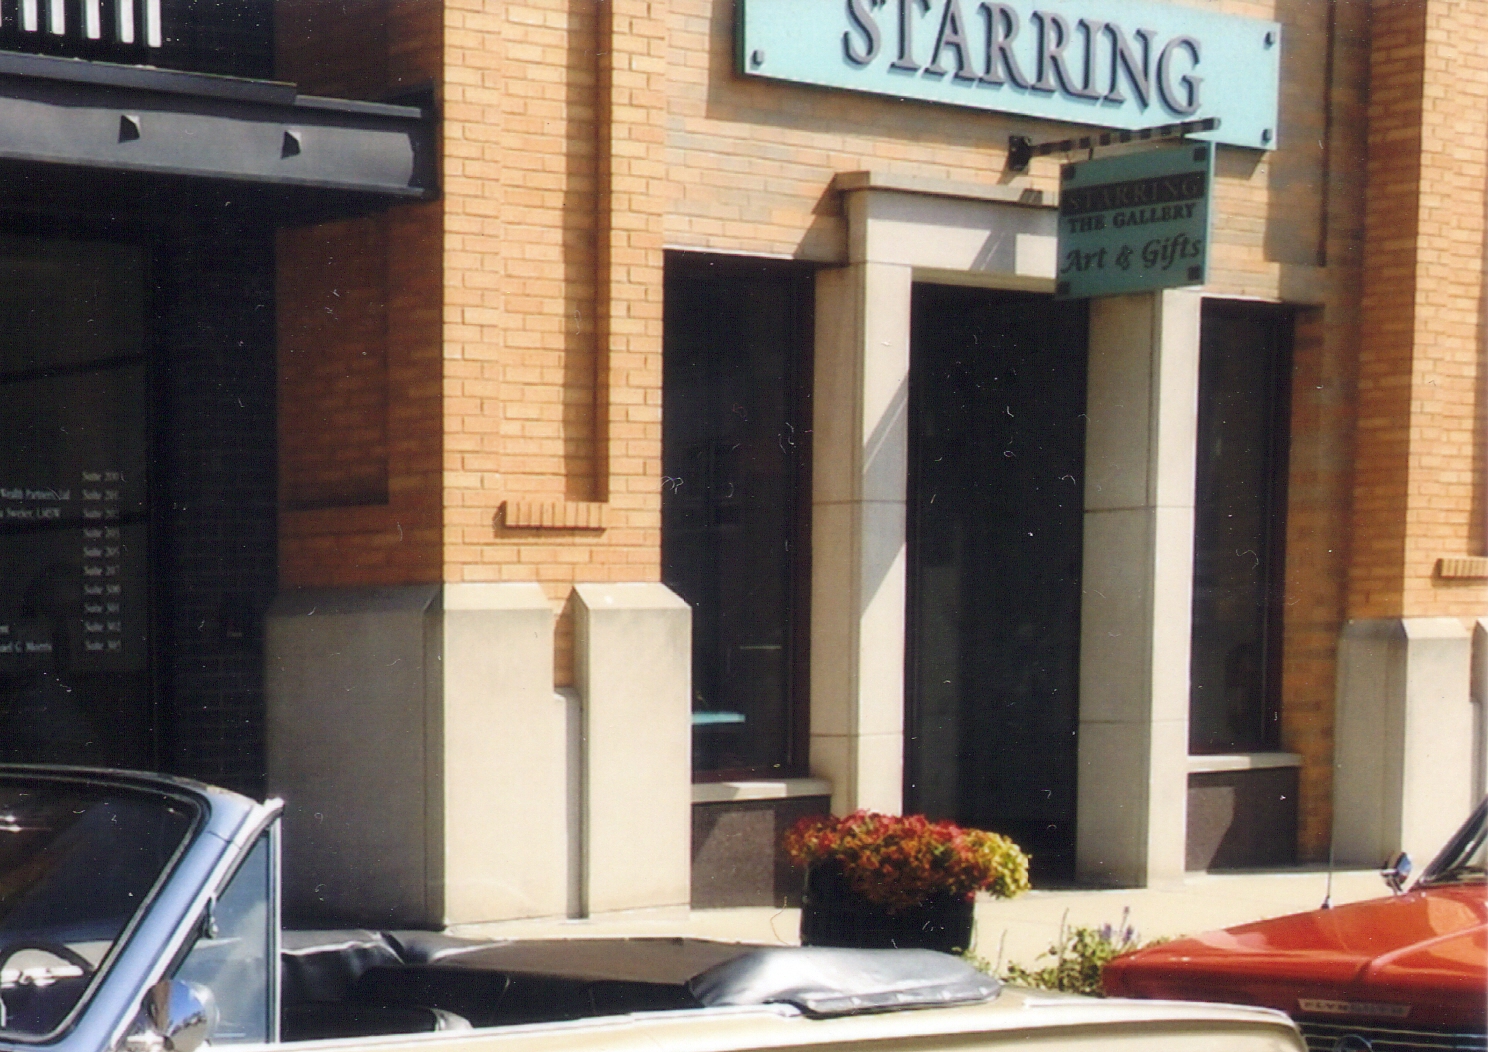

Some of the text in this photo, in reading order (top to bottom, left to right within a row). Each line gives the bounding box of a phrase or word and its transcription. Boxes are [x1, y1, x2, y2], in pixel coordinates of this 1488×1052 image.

[842, 0, 1204, 116] STARRING
[1069, 202, 1196, 233] THE GALLERY
[1060, 246, 1108, 275] Art
[1141, 232, 1202, 271] Gifts
